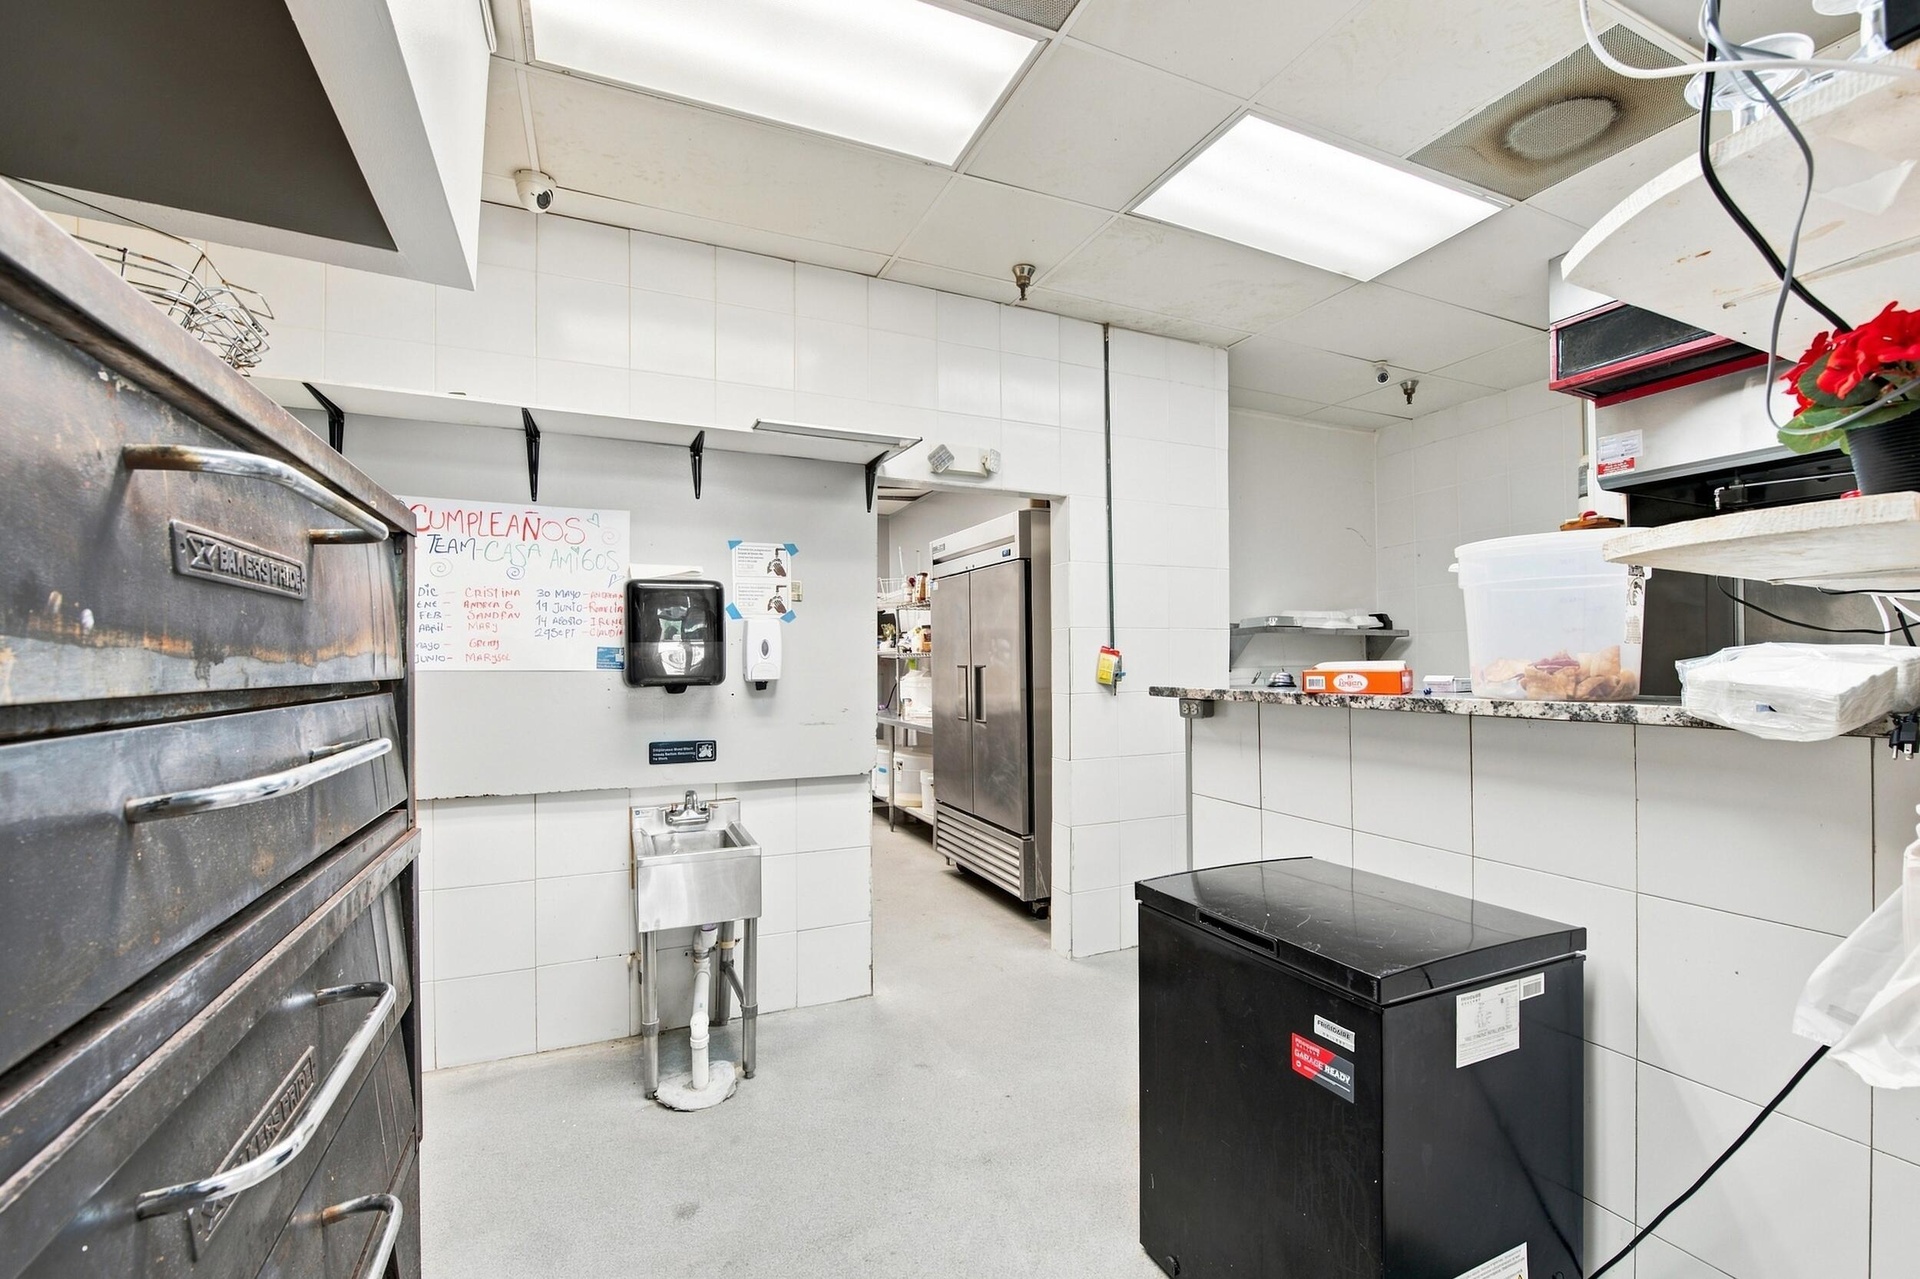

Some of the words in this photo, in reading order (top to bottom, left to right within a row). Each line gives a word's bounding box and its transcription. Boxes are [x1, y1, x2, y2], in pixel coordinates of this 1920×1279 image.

[410, 504, 585, 545] CUMPLEAÑOS
[219, 545, 270, 582] BAKERS
[271, 560, 301, 593] PRIDE
[537, 588, 551, 597] 30
[536, 600, 548, 612] 19
[535, 615, 548, 627] 14
[1317, 1019, 1351, 1040] FRIGIDAIRE
